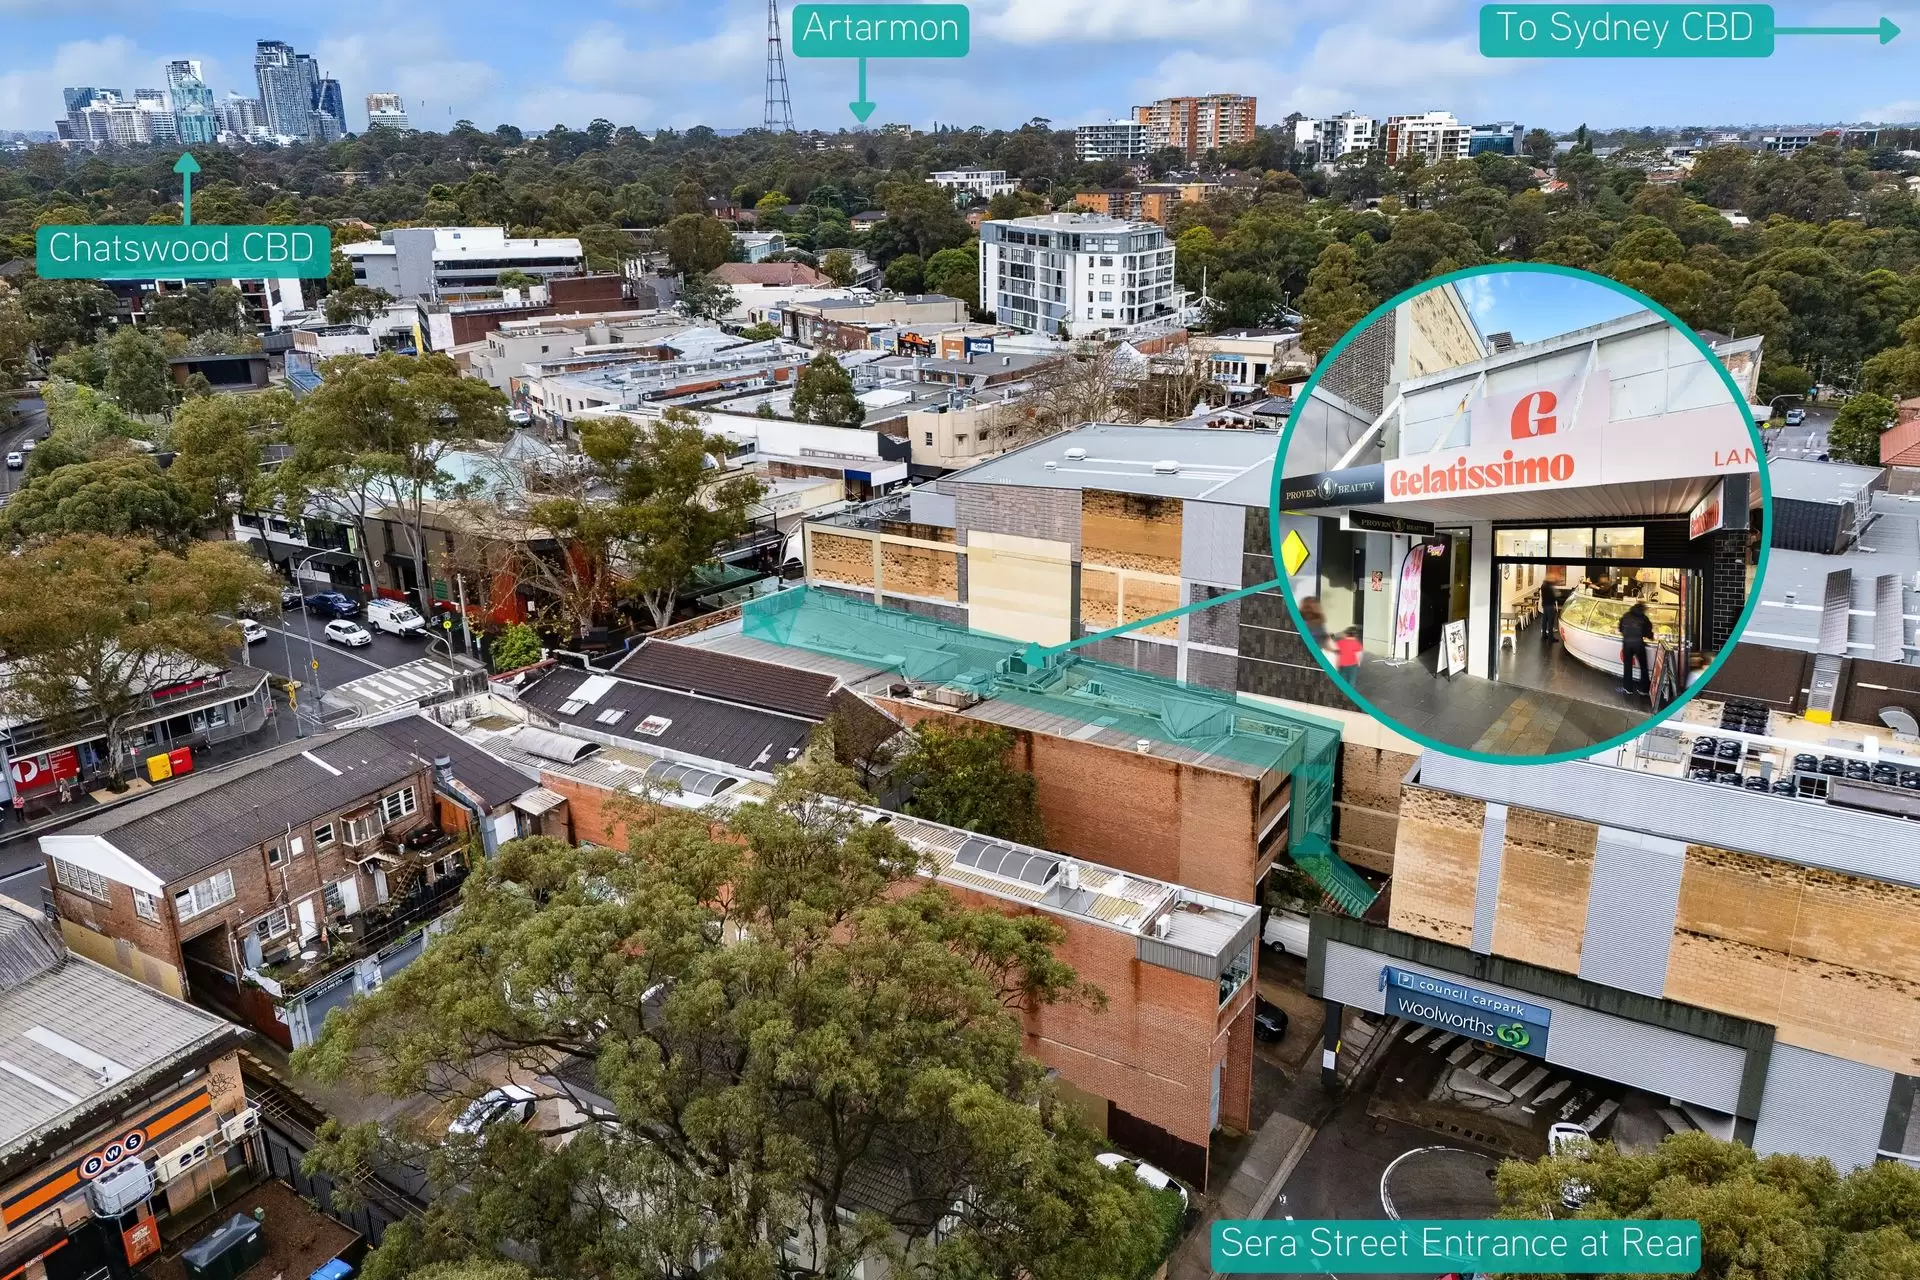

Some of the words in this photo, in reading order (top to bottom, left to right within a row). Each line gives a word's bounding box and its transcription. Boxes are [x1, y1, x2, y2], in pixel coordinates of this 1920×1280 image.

[1510, 391, 1558, 440] G
[1390, 450, 1575, 497] Gelatissimo
[1714, 447, 1758, 467] LAN
[1286, 488, 1317, 500] PROVEN
[1337, 481, 1375, 494] BEAUTY
[1361, 519, 1391, 528] PROVEN
[1419, 980, 1468, 1000] council
[1472, 994, 1525, 1016] carpark
[1398, 998, 1494, 1037] Woolworths
